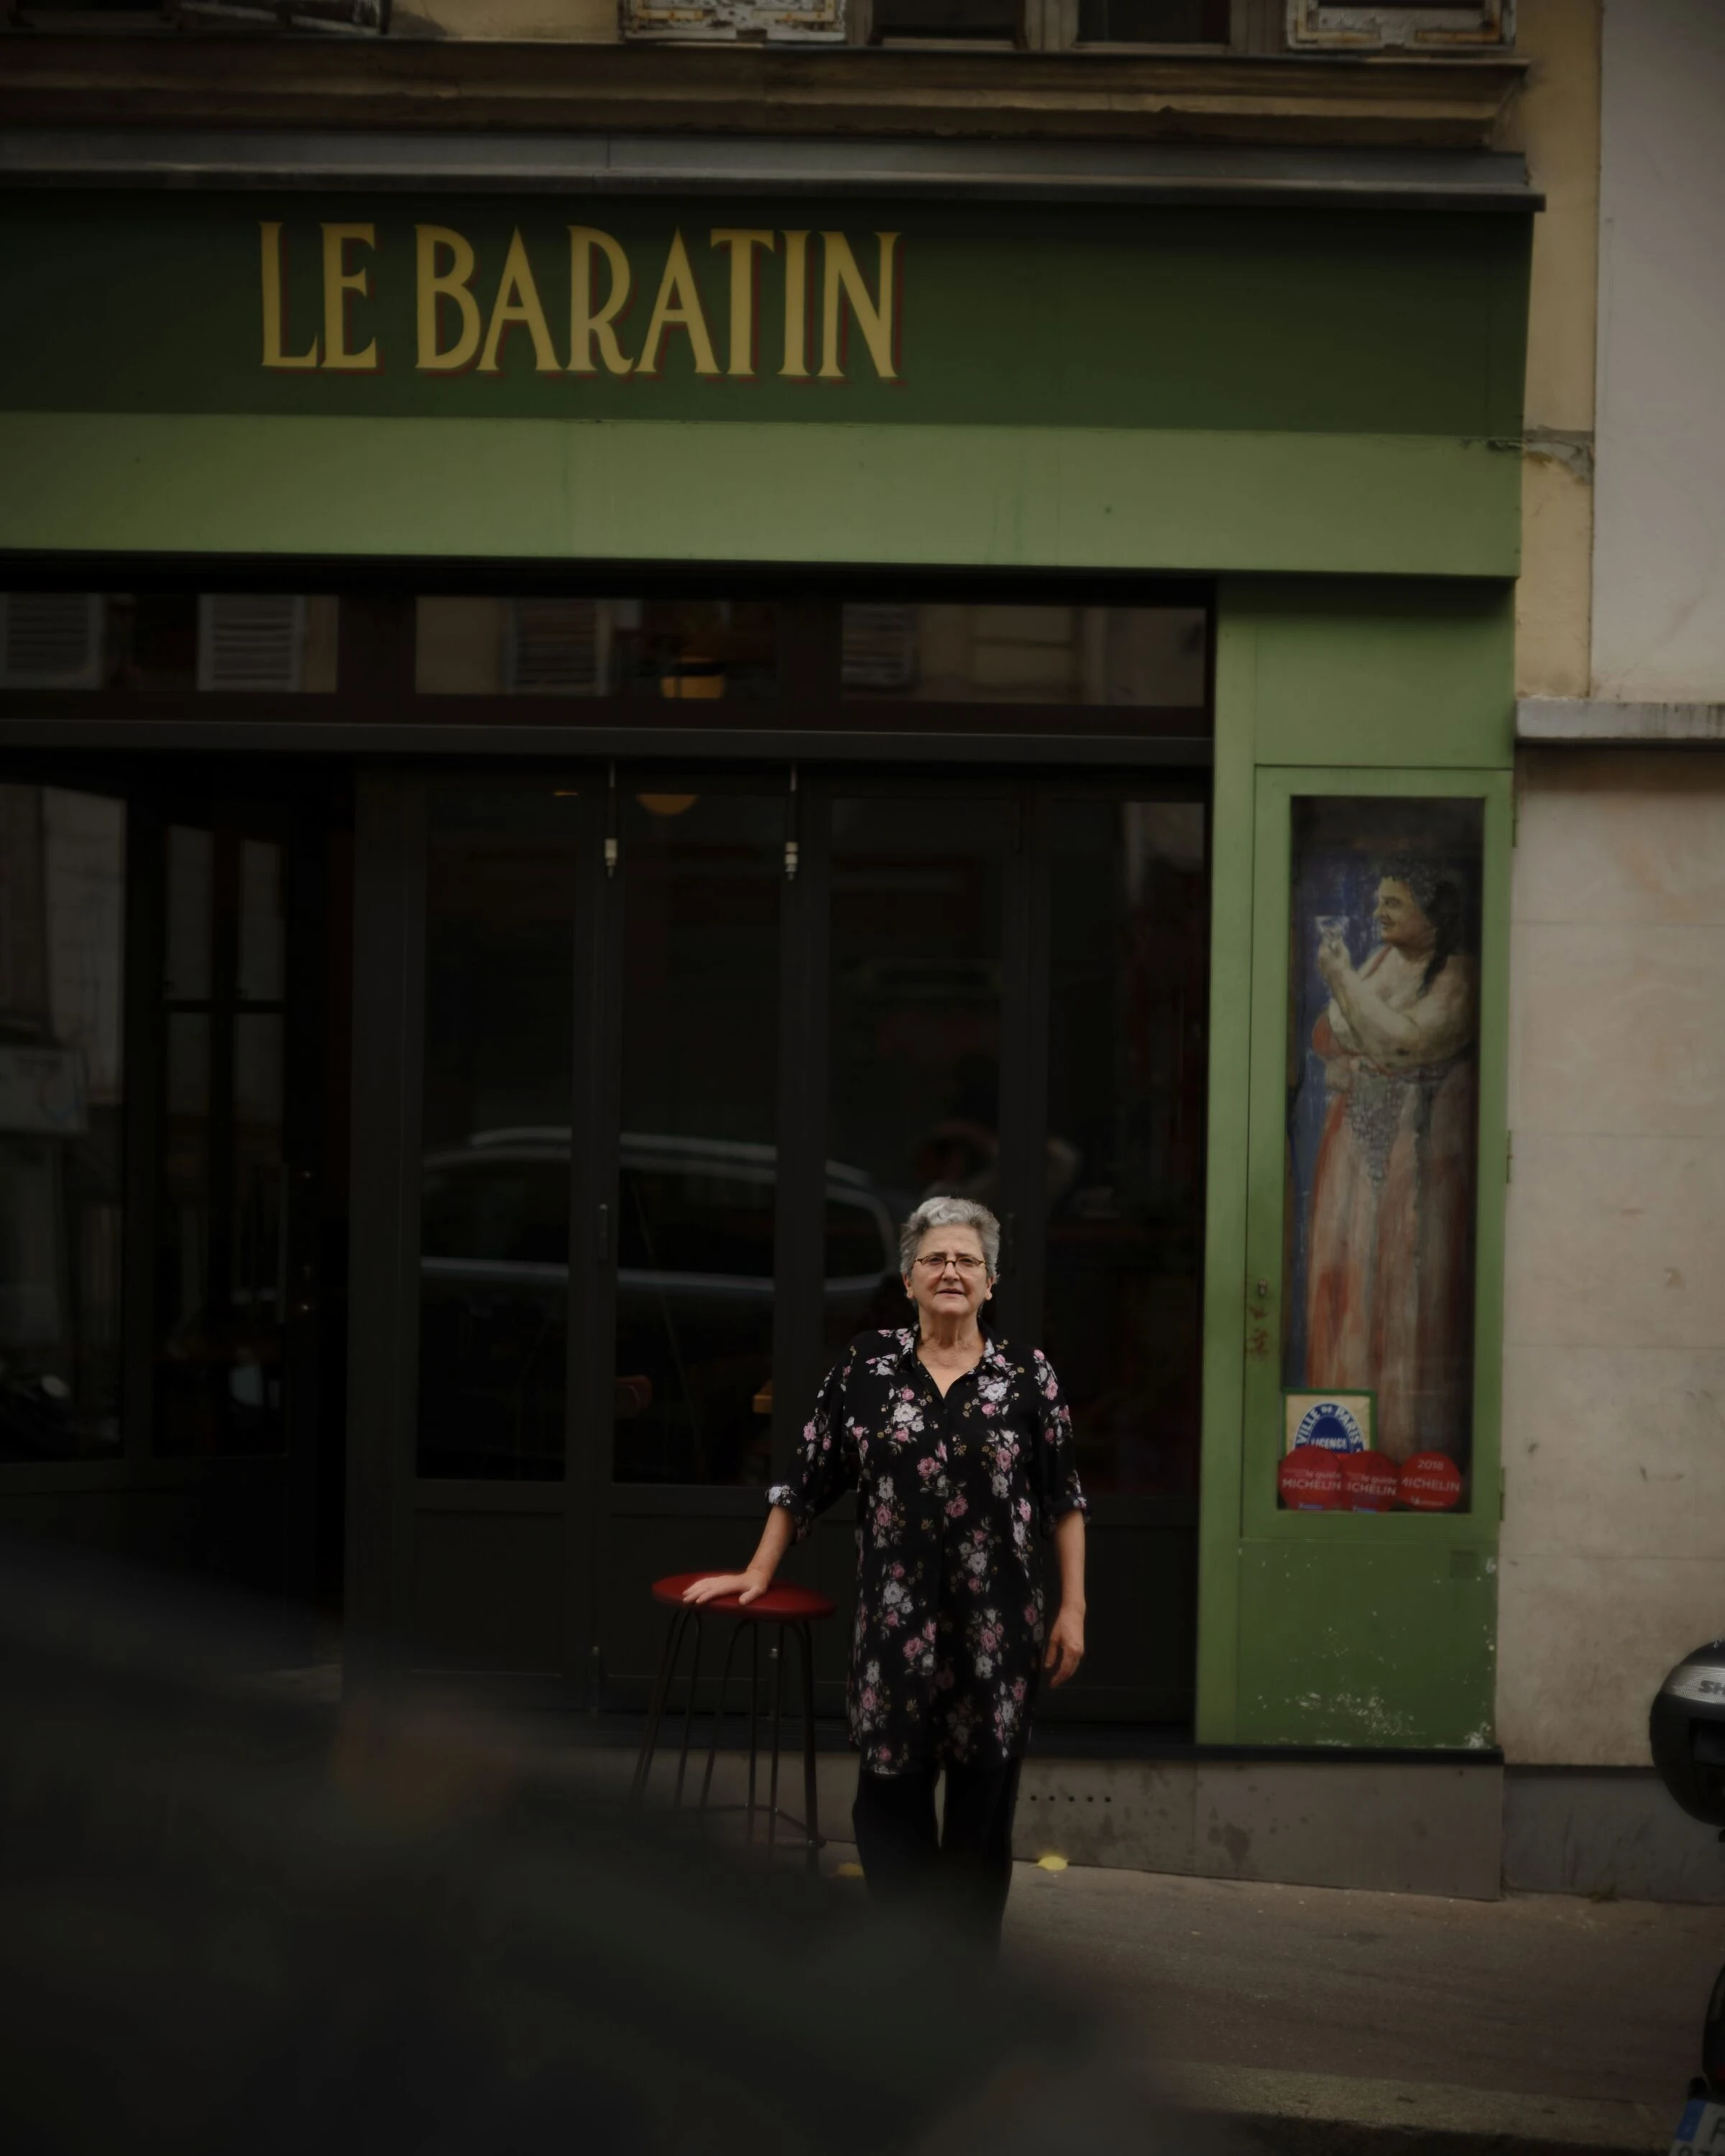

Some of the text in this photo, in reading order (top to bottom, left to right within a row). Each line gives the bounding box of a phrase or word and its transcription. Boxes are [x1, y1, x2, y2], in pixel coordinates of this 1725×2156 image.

[259, 221, 905, 381] LE BARATIN
[1296, 1408, 1321, 1445] VILLE
[1334, 1406, 1362, 1445] PARIS
[1282, 1478, 1342, 1491] MICHELIN
[1347, 1482, 1397, 1496] ICHELIN
